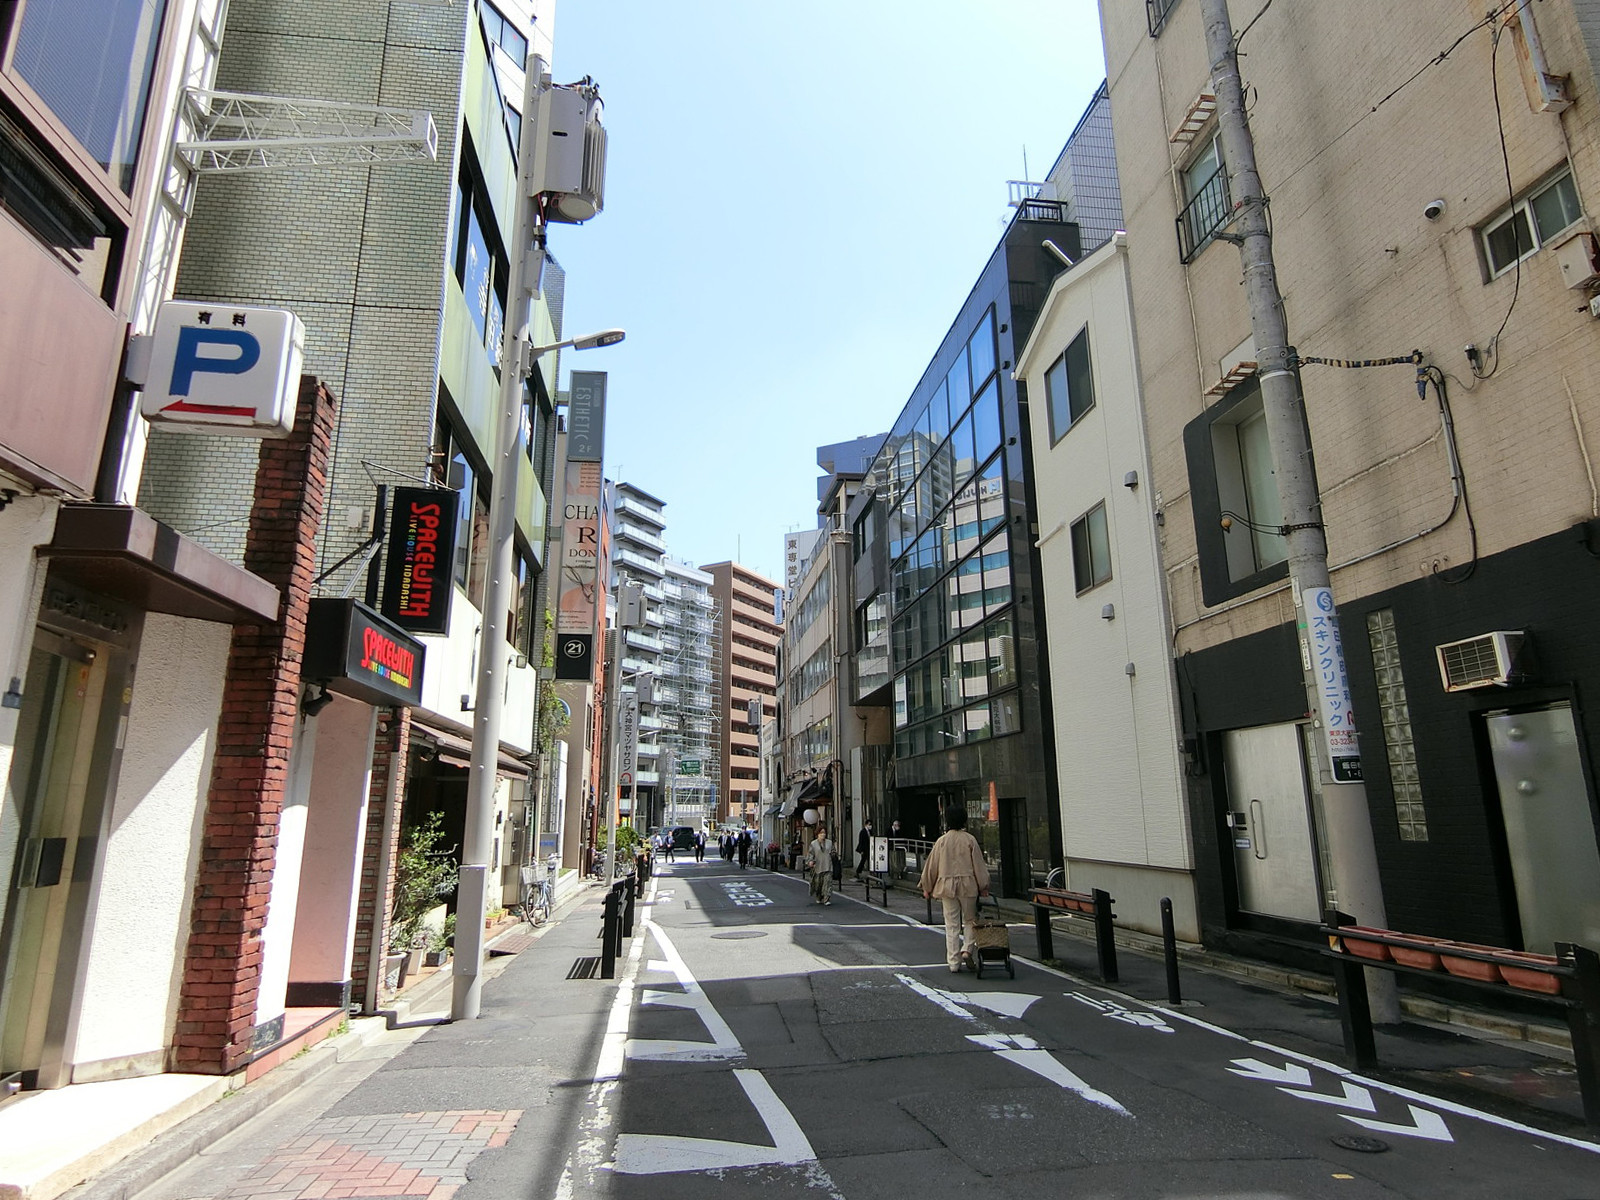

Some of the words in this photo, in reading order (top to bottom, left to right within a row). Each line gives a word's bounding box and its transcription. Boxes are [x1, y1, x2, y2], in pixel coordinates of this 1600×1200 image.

[168, 327, 261, 396] P
[574, 386, 592, 442] ESTHETIC
[578, 444, 593, 454] 2F
[405, 534, 416, 562] HOUSE
[408, 514, 419, 534] LIVE
[398, 501, 441, 618] SPACEWITH
[361, 627, 414, 689] SPACEWITH
[567, 642, 582, 655] 21
[1313, 616, 1343, 727] スキンクリニック
